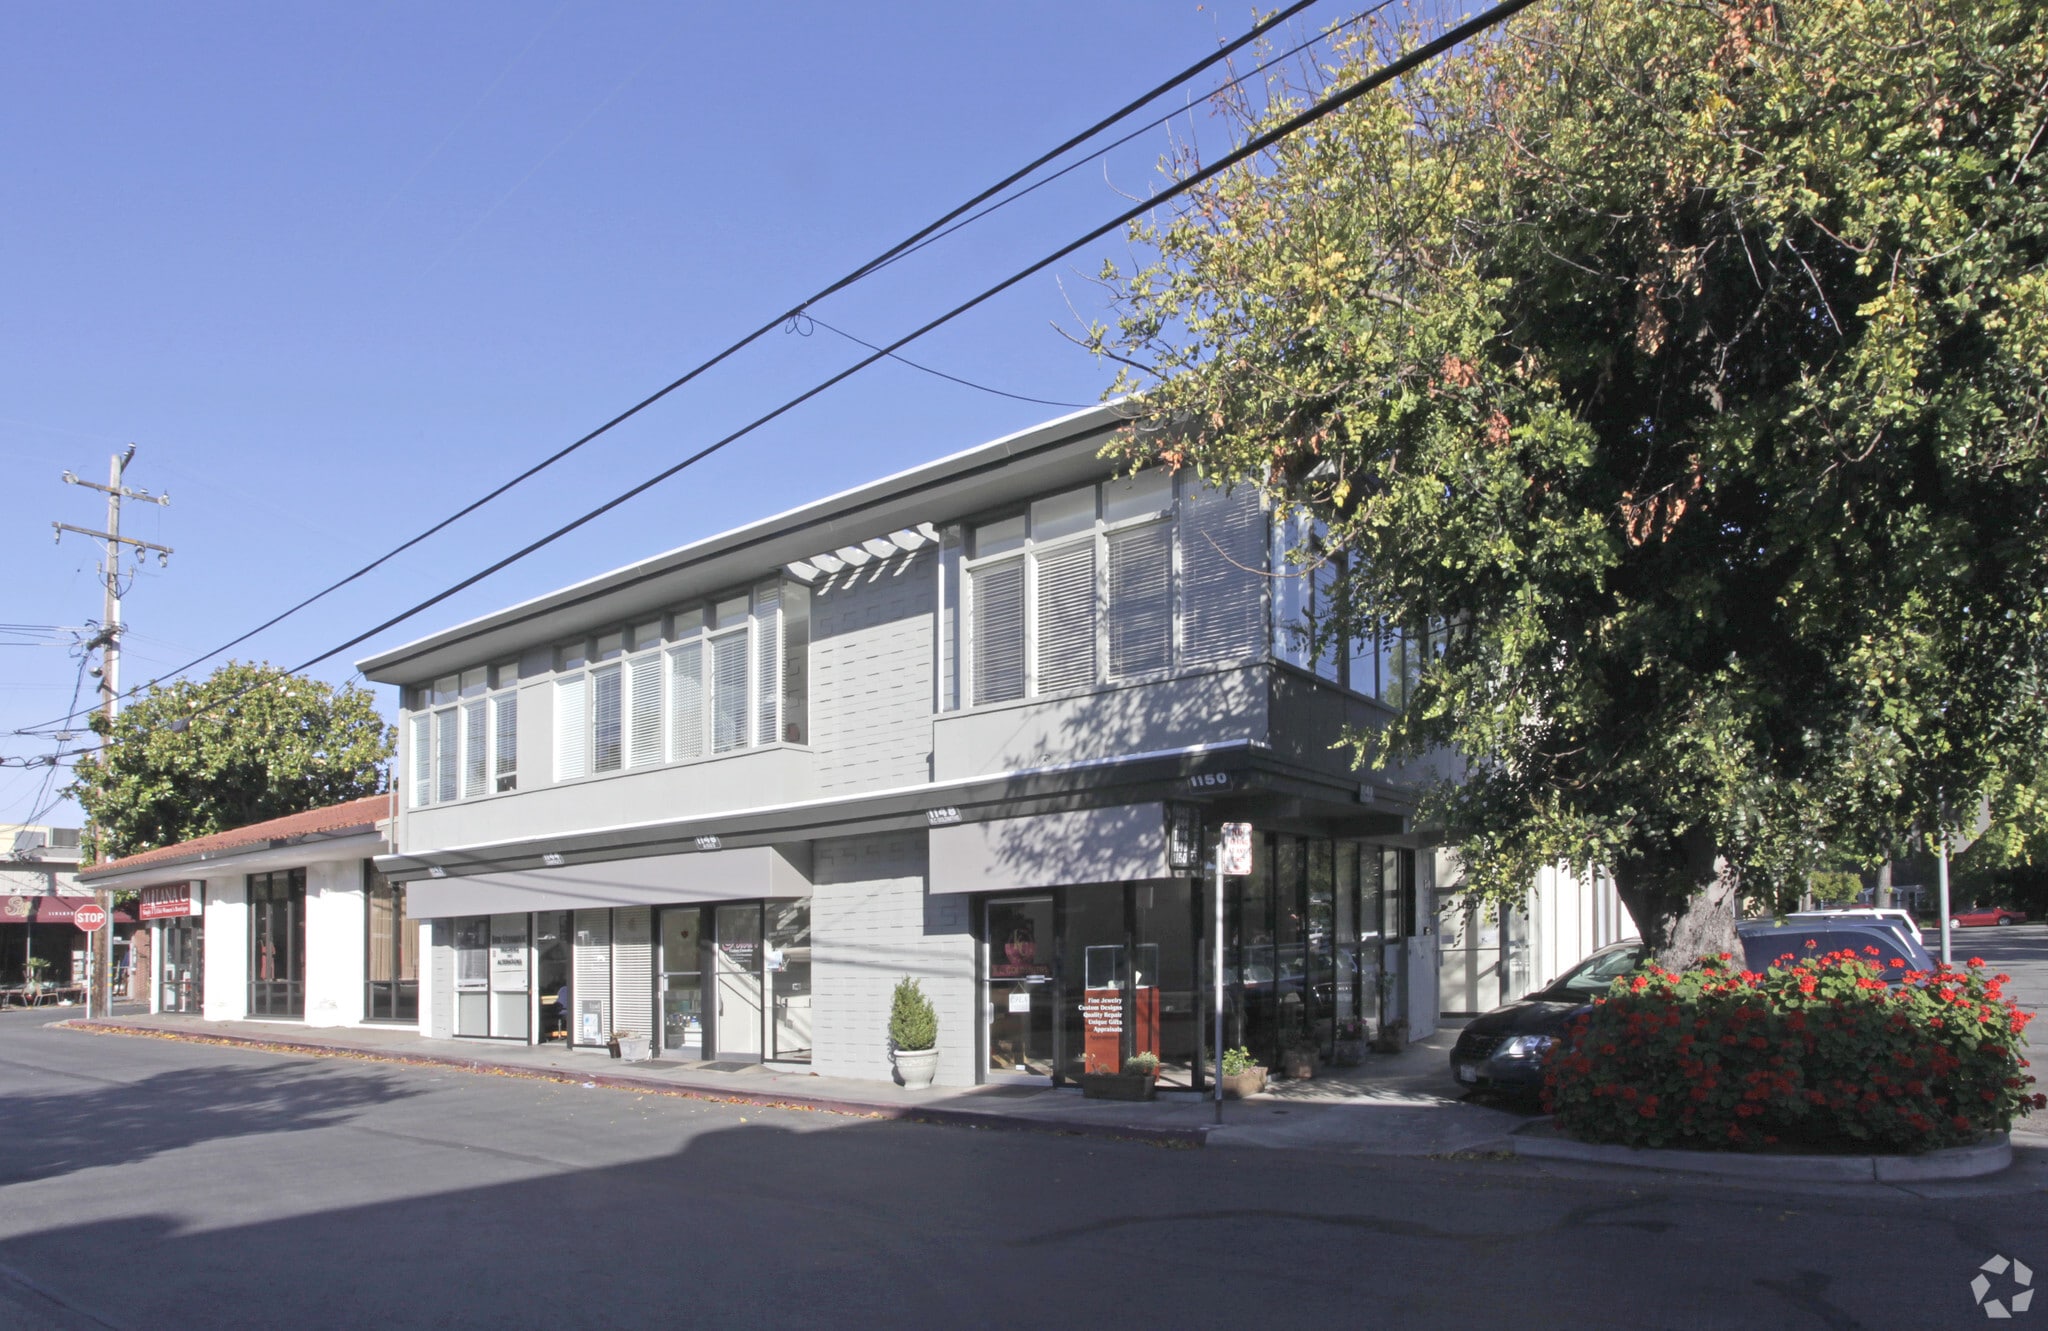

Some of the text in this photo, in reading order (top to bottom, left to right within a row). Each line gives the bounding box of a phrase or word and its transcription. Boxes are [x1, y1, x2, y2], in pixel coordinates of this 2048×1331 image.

[1190, 772, 1227, 787] 1150
[1173, 852, 1188, 864] 1150
[77, 912, 105, 924] STOP
[1101, 997, 1123, 1005] Jewelry
[1100, 1004, 1123, 1012] Designs
[1083, 1011, 1123, 1019] Quality Repair
[1108, 1018, 1123, 1026] Gifts
